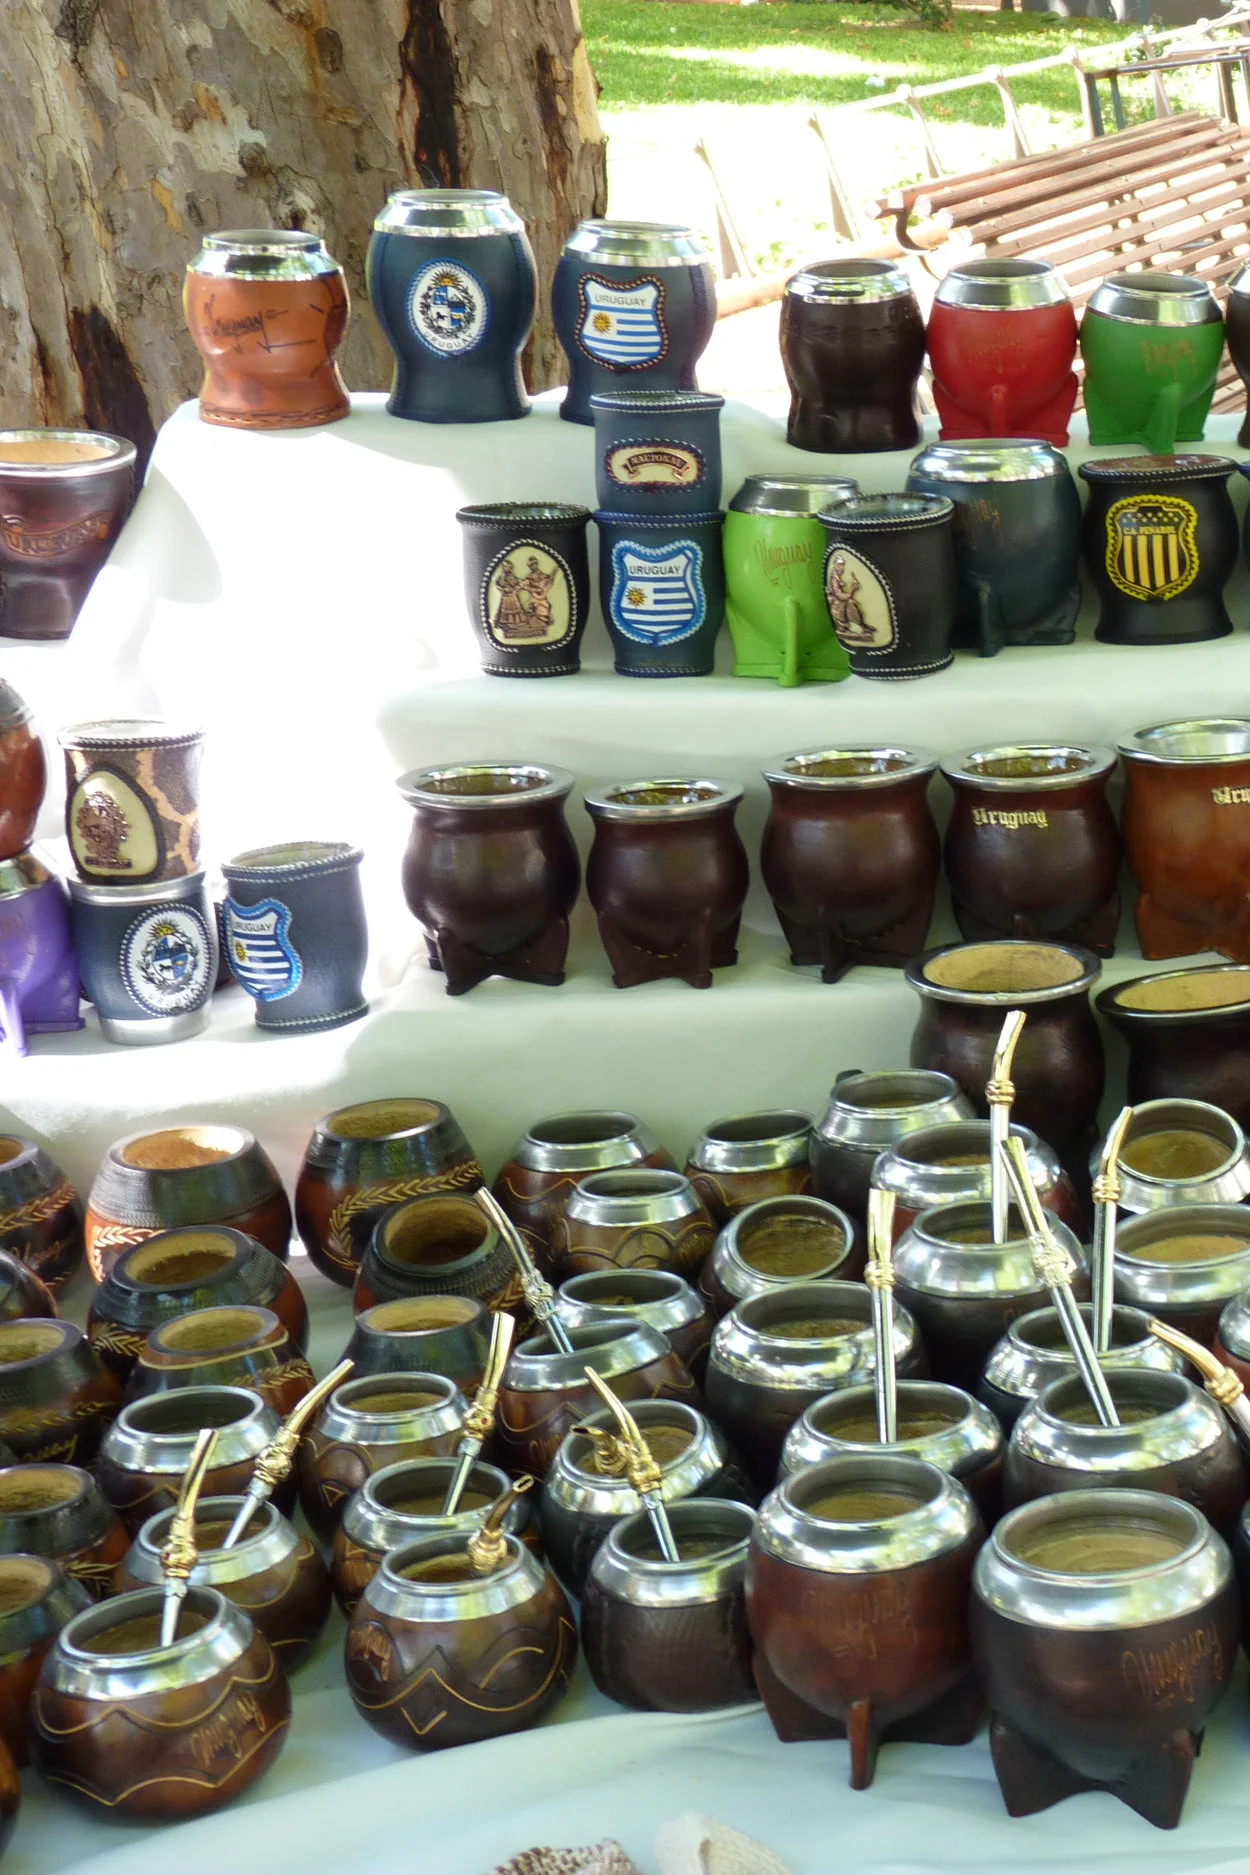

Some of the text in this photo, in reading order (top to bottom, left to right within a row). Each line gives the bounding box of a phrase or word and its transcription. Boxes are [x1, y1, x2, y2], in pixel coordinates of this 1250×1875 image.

[594, 294, 647, 306] URUGUAY
[629, 565, 681, 576] URUGUAY
[971, 806, 1050, 829] Uruguay
